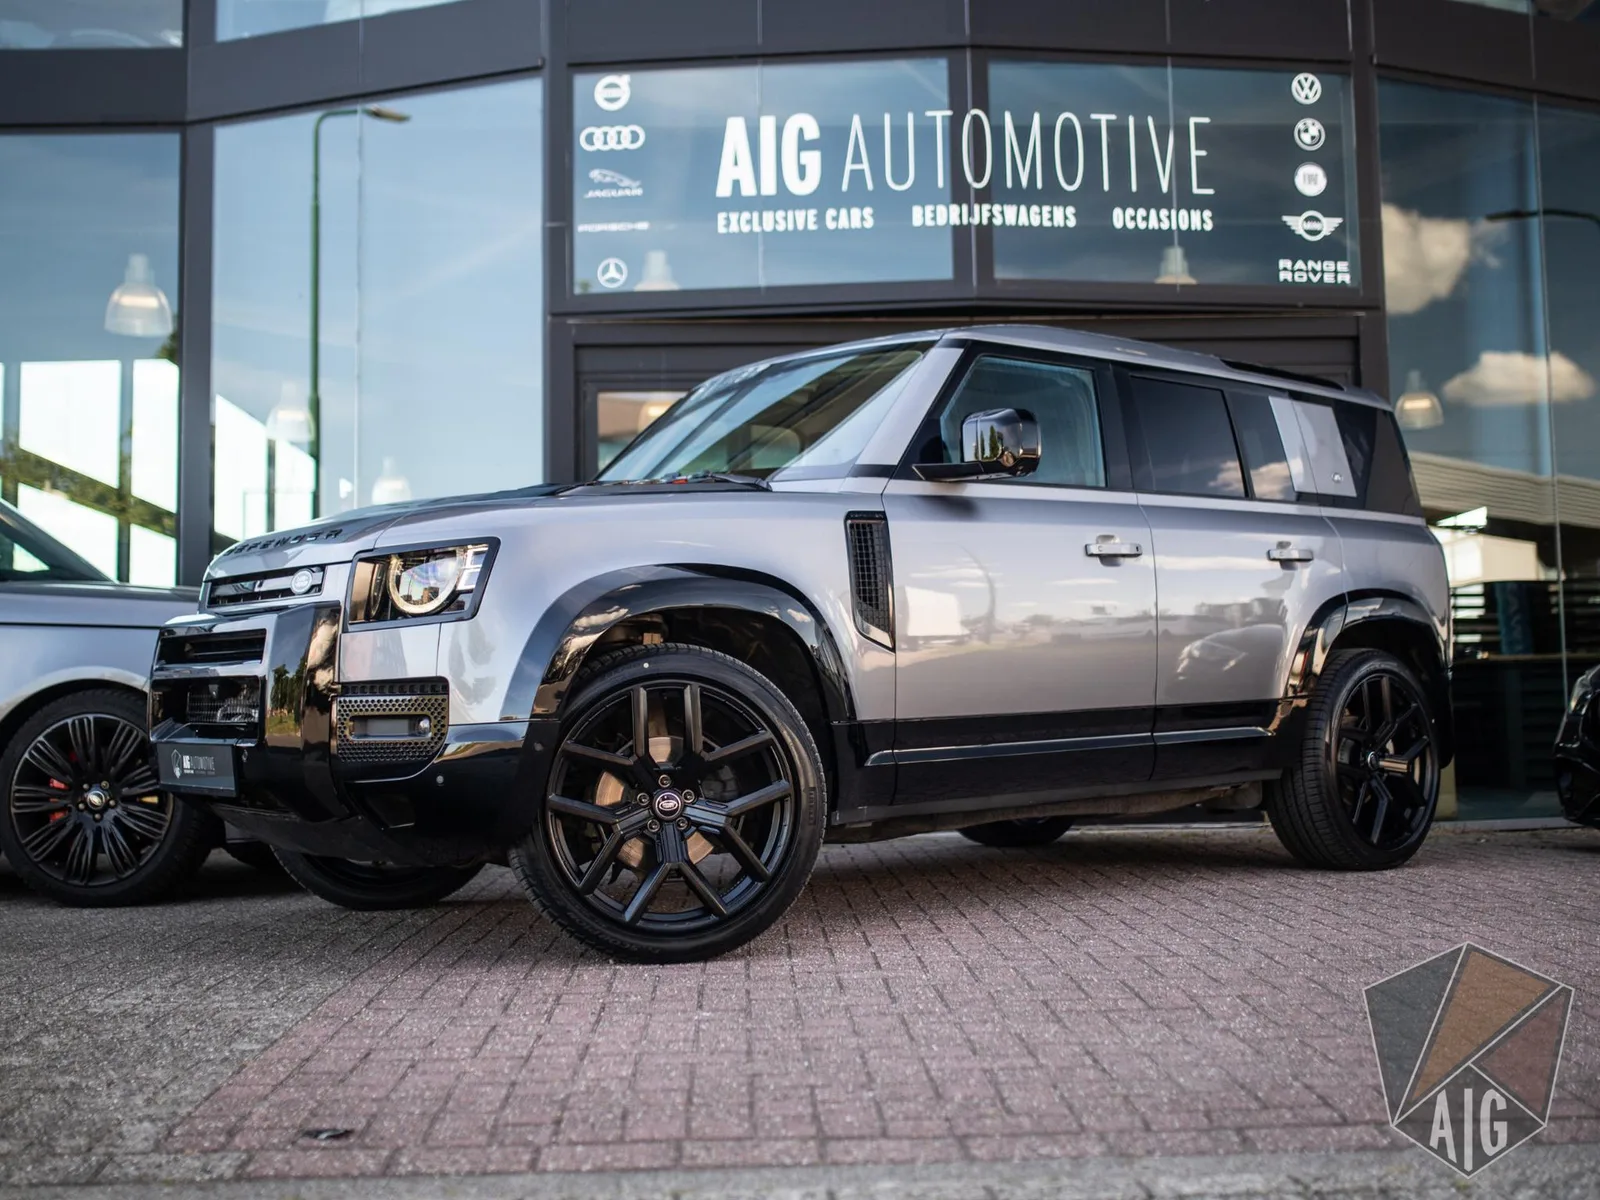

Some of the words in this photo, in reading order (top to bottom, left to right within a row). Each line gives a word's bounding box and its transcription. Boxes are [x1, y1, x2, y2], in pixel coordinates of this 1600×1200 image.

[716, 113, 822, 197] AIG
[841, 109, 1215, 194] AUTOMOTIVE
[717, 209, 818, 233] EXCLUSIVE
[825, 206, 874, 229] CARS
[912, 203, 1076, 228] BEDRIJFSWAGENS
[1112, 207, 1213, 231] OCCASIONS
[1279, 259, 1349, 271] RANGE
[1279, 270, 1351, 284] ROVER
